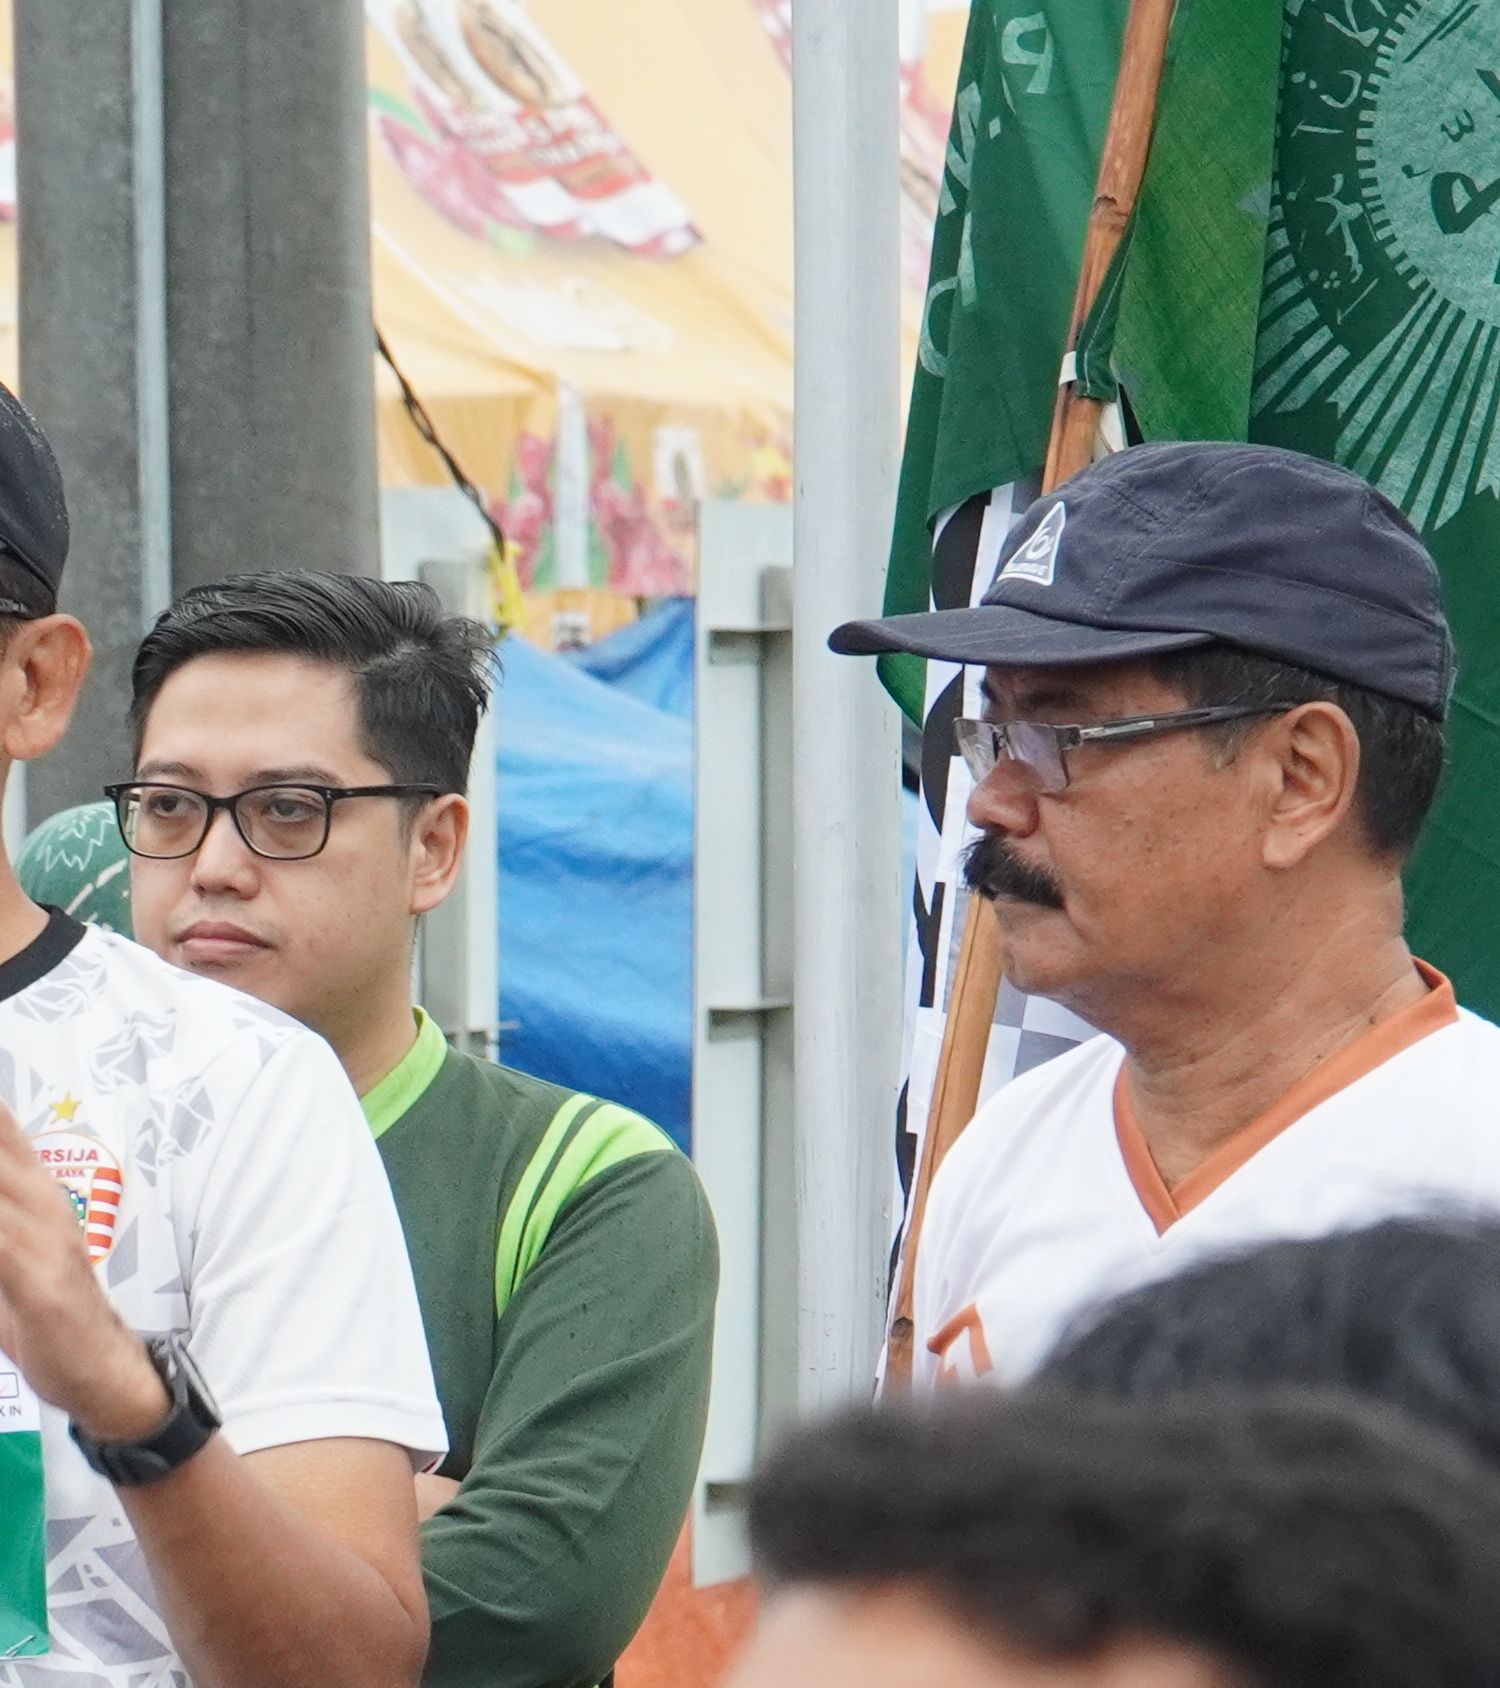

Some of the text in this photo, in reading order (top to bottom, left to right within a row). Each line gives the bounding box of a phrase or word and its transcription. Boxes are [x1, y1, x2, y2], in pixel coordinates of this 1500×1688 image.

[36, 1148, 100, 1163] RSIJA
[56, 1169, 86, 1179] RAYA
[9, 1405, 22, 1417] IN
